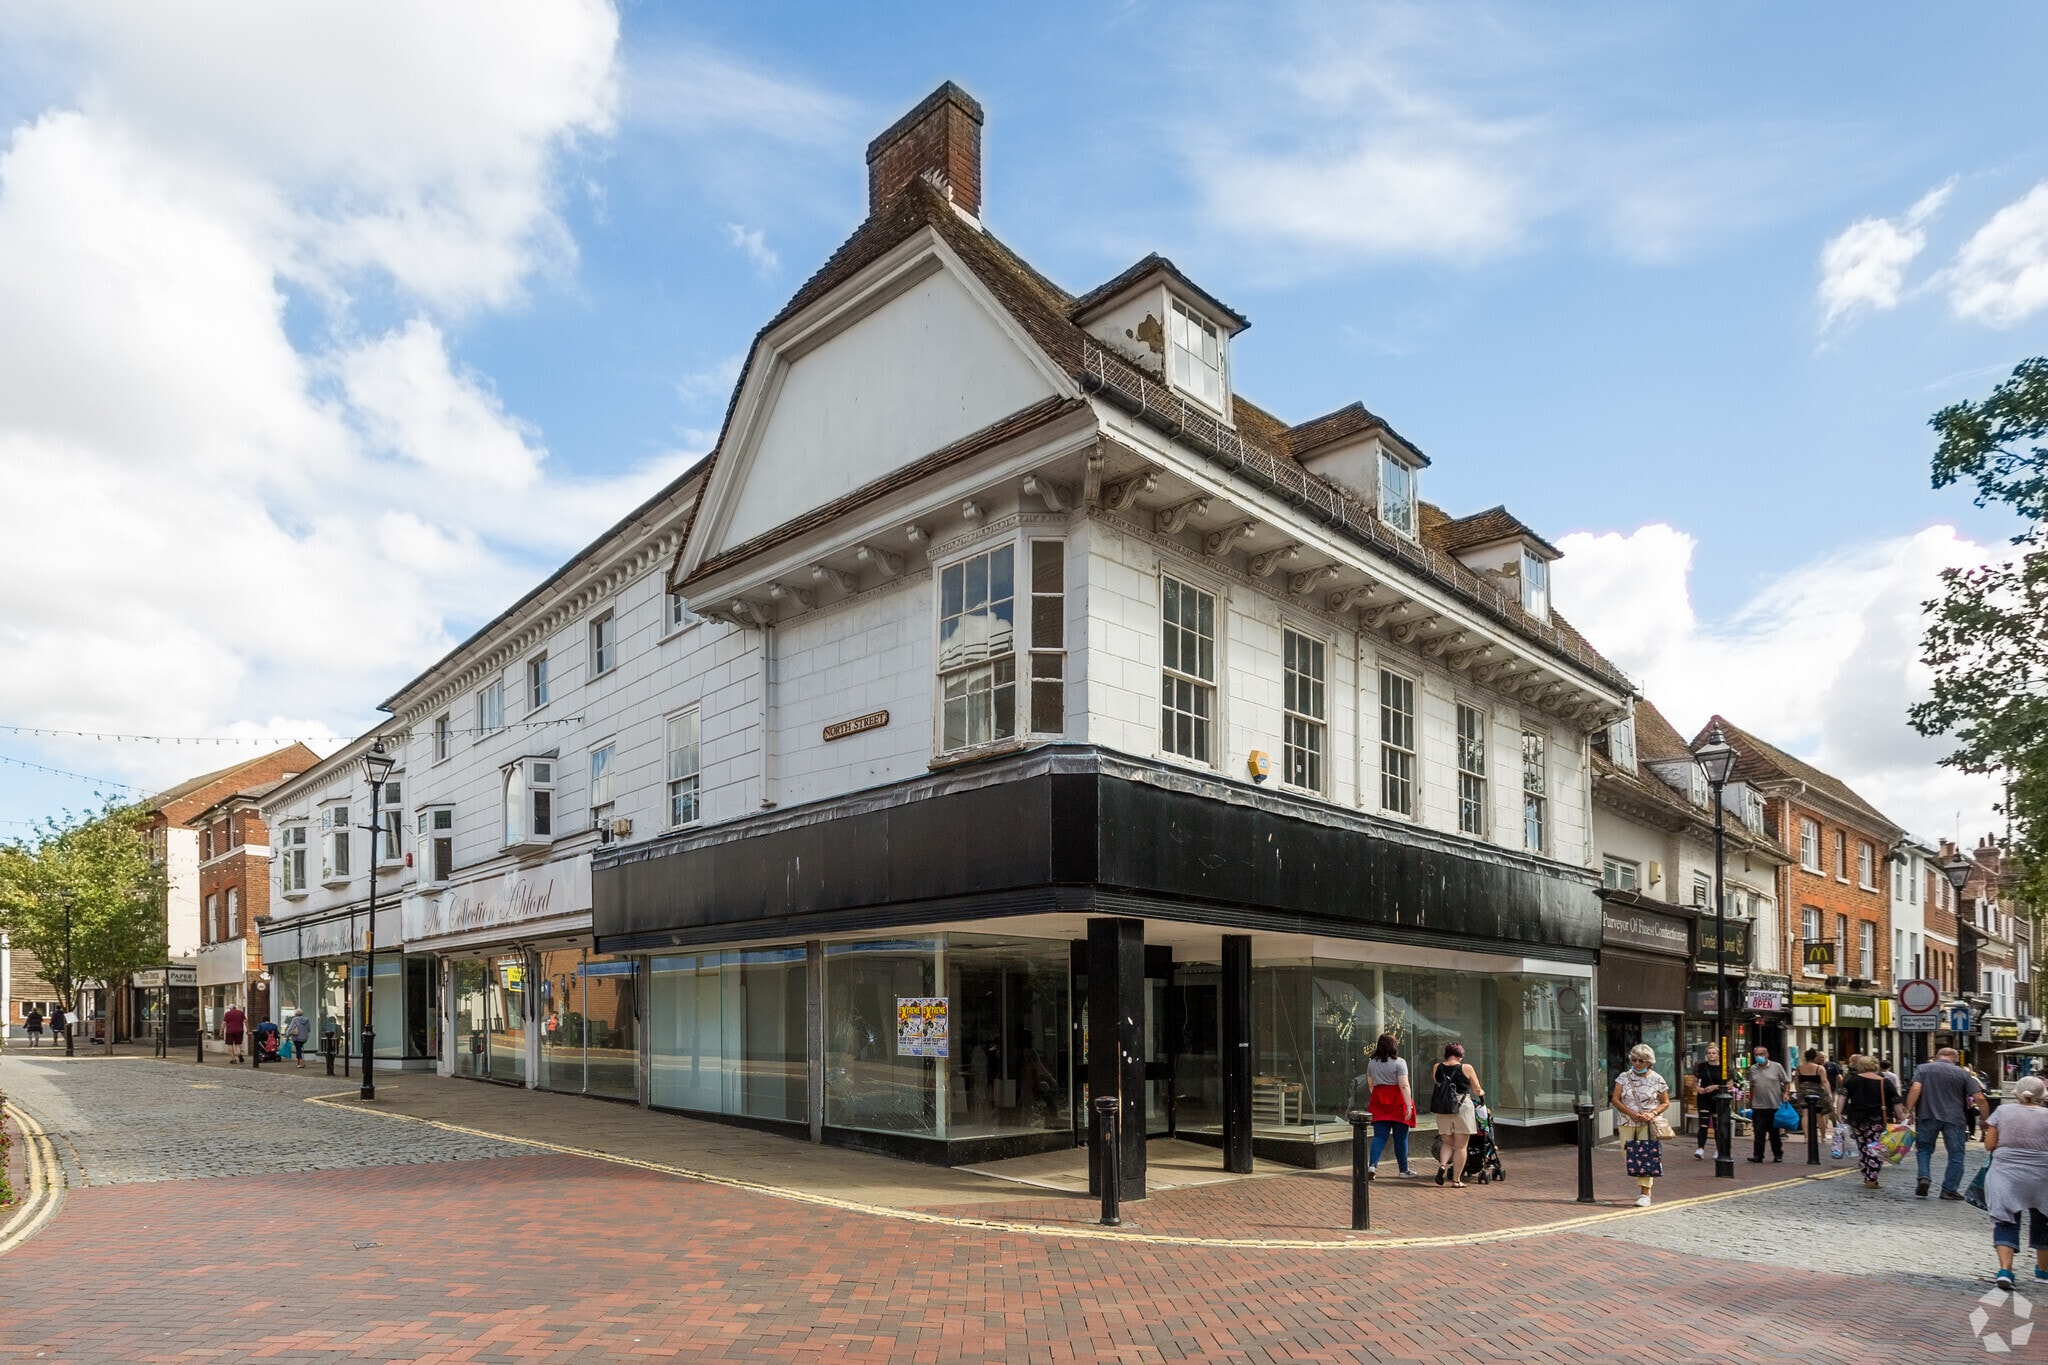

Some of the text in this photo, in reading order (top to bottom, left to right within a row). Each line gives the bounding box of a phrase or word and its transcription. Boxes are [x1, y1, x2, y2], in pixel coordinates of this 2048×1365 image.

[825, 713, 885, 736] NORTH STREET
[425, 878, 554, 933] The Collection Ashford
[1603, 911, 1688, 946] Purveyor Of Finest Confectionery
[899, 1006, 921, 1019] EXTREME
[923, 1006, 946, 1019] EXTREME
[1753, 1000, 1773, 1009] OPEN
